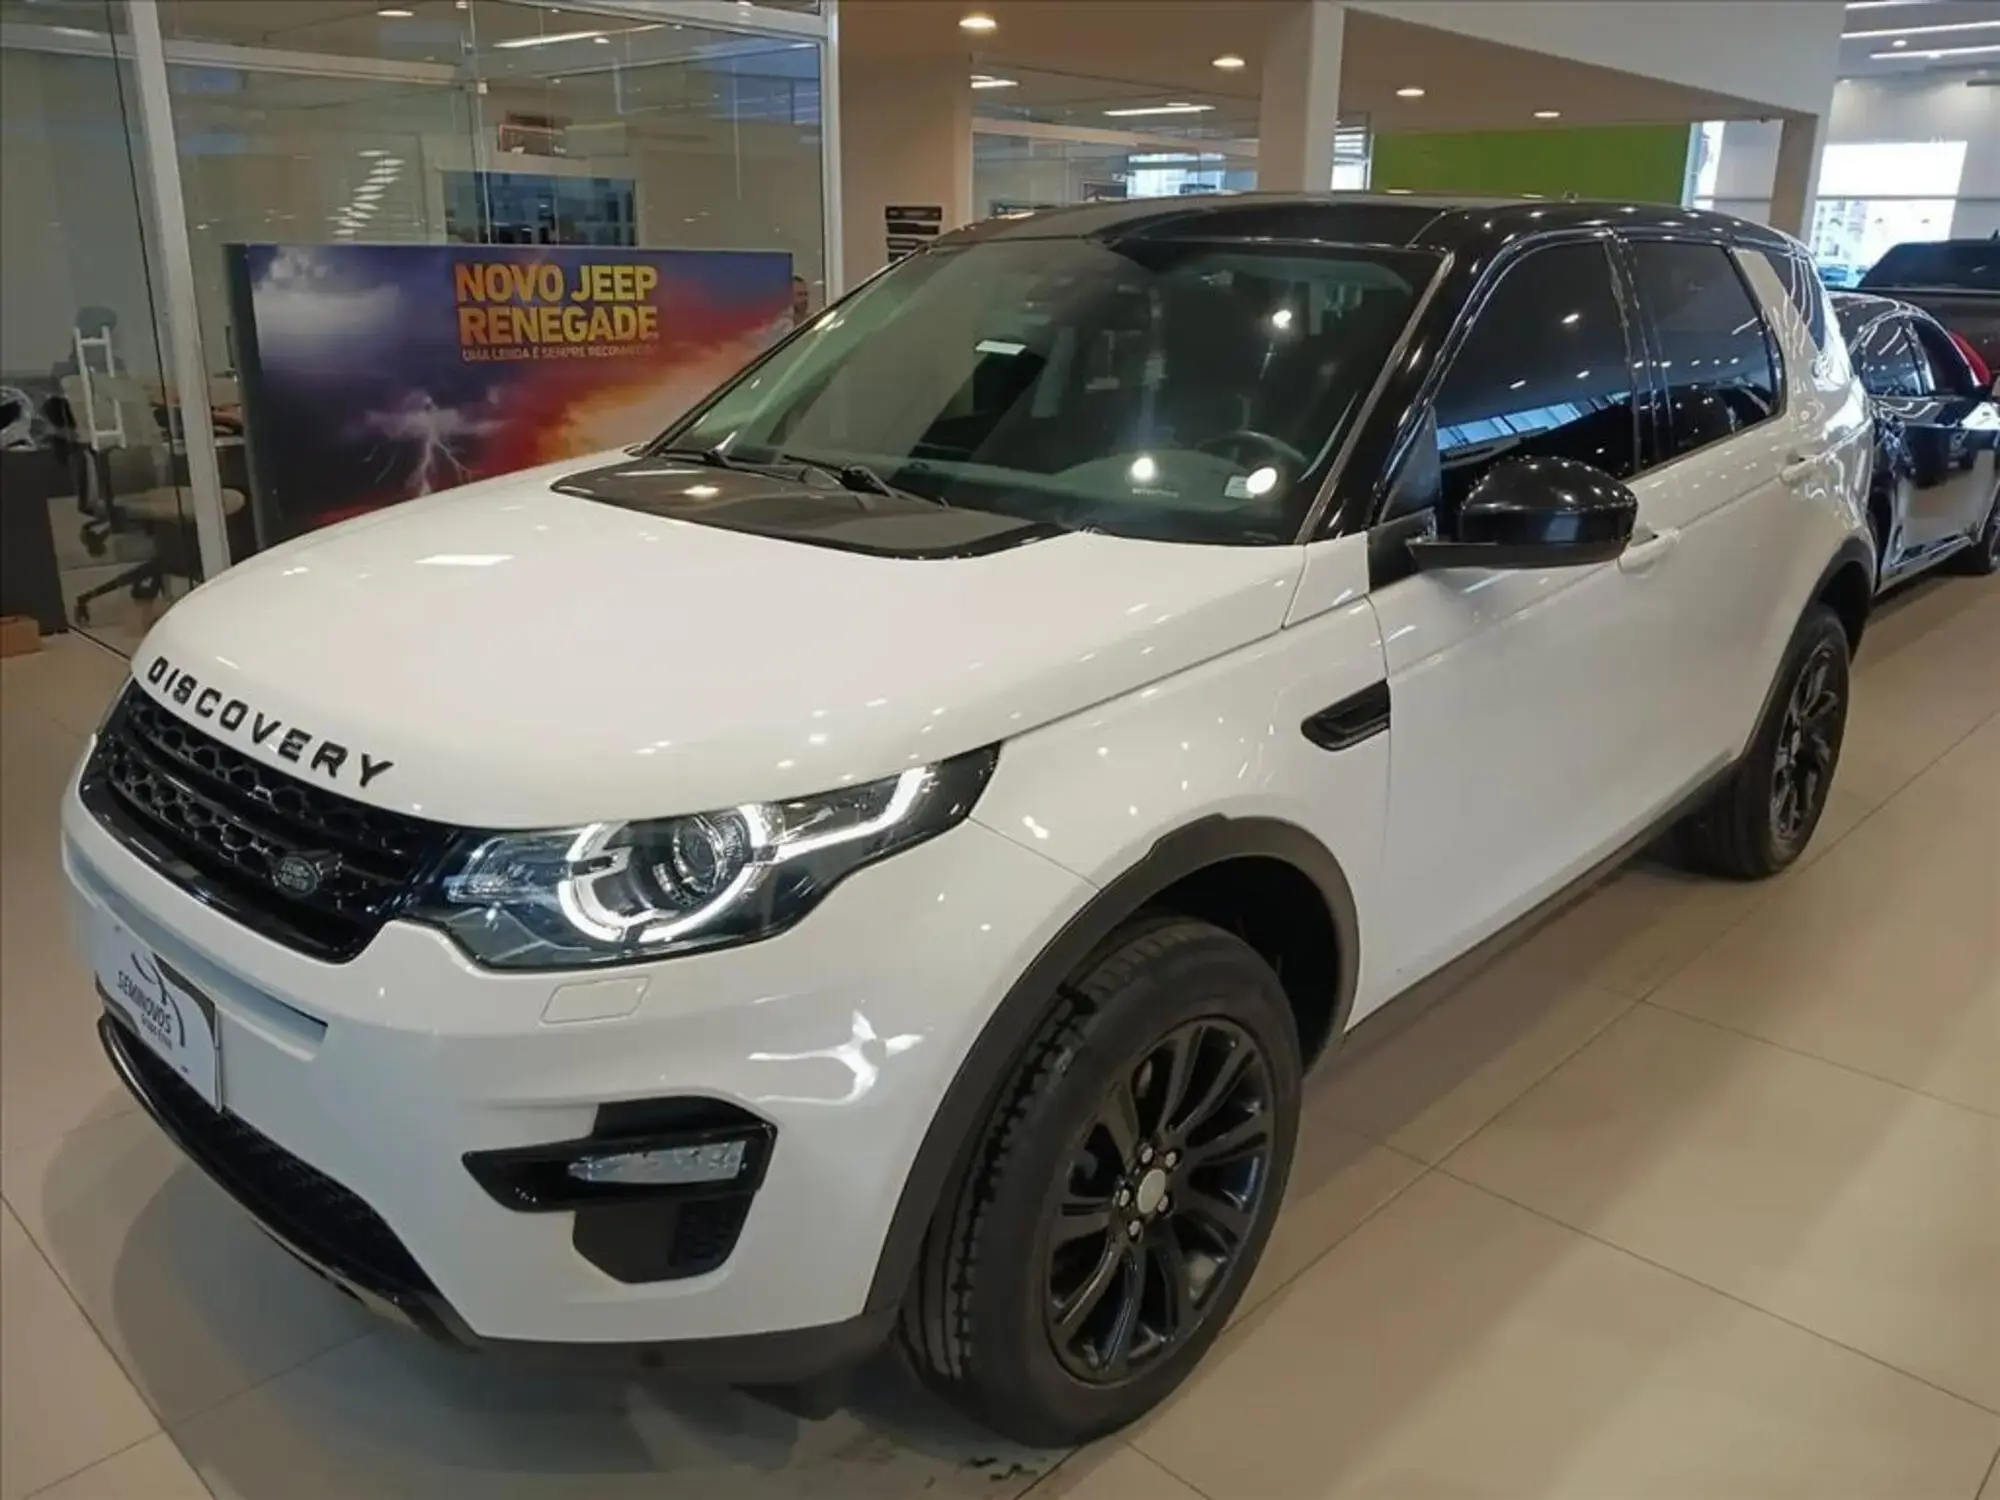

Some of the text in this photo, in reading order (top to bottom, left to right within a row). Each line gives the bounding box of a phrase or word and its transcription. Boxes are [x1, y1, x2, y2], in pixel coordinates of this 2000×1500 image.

[456, 264, 658, 302] NOVO JEEP
[459, 306, 657, 344] RENEGADE
[147, 656, 394, 788] DISCOVERY
